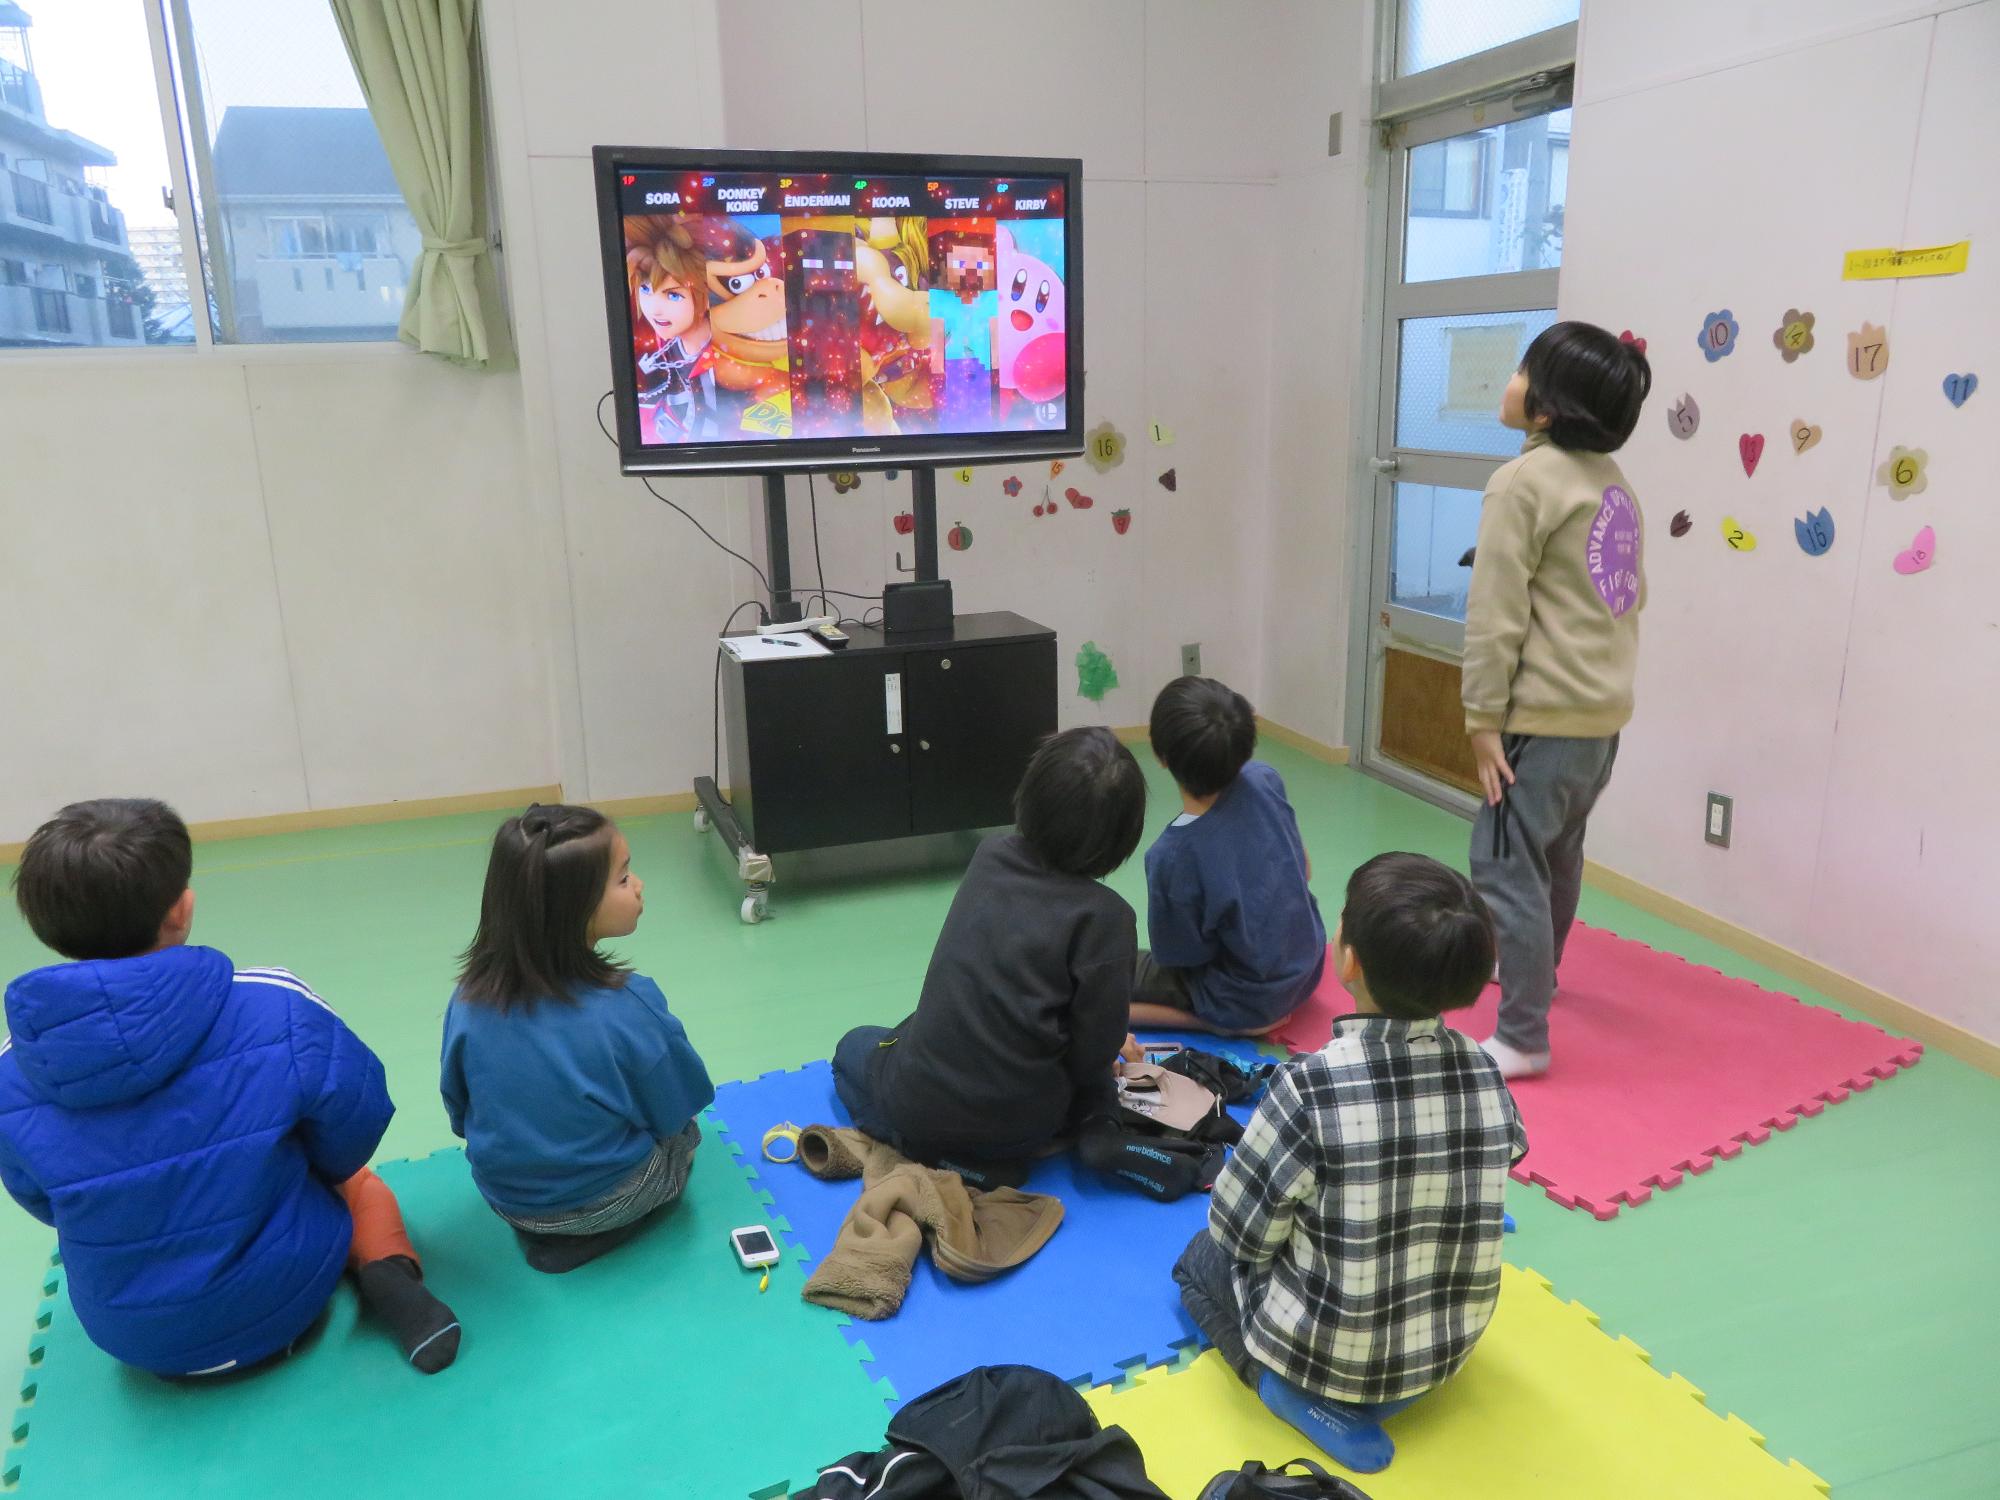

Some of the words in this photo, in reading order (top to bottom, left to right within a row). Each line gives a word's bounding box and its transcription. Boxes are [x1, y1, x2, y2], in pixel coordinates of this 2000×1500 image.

[623, 175, 635, 185] 1P
[702, 177, 715, 187] 2P
[780, 178, 792, 189] 3P
[855, 181, 867, 190] 4P
[927, 182, 939, 192] 5P
[997, 184, 1009, 193] 6P
[645, 192, 680, 205] SORA
[718, 187, 766, 201] DONKEY
[726, 200, 759, 213] KONG
[784, 194, 850, 208] ENDERMAN
[872, 196, 910, 209] KOOPA
[945, 198, 979, 210] STEVE
[1015, 199, 1047, 211] KIRBY
[1709, 322, 1729, 349] 10
[1855, 343, 1883, 372] 17
[1951, 378, 1971, 401] 11
[1676, 407, 1693, 433] 5
[1154, 425, 1161, 441] 1
[1797, 427, 1811, 451] 9
[852, 446, 880, 454] Panasonic
[1098, 438, 1113, 457] 16
[1895, 459, 1913, 484] 6
[1728, 530, 1744, 549] 2
[1807, 522, 1828, 551] 16
